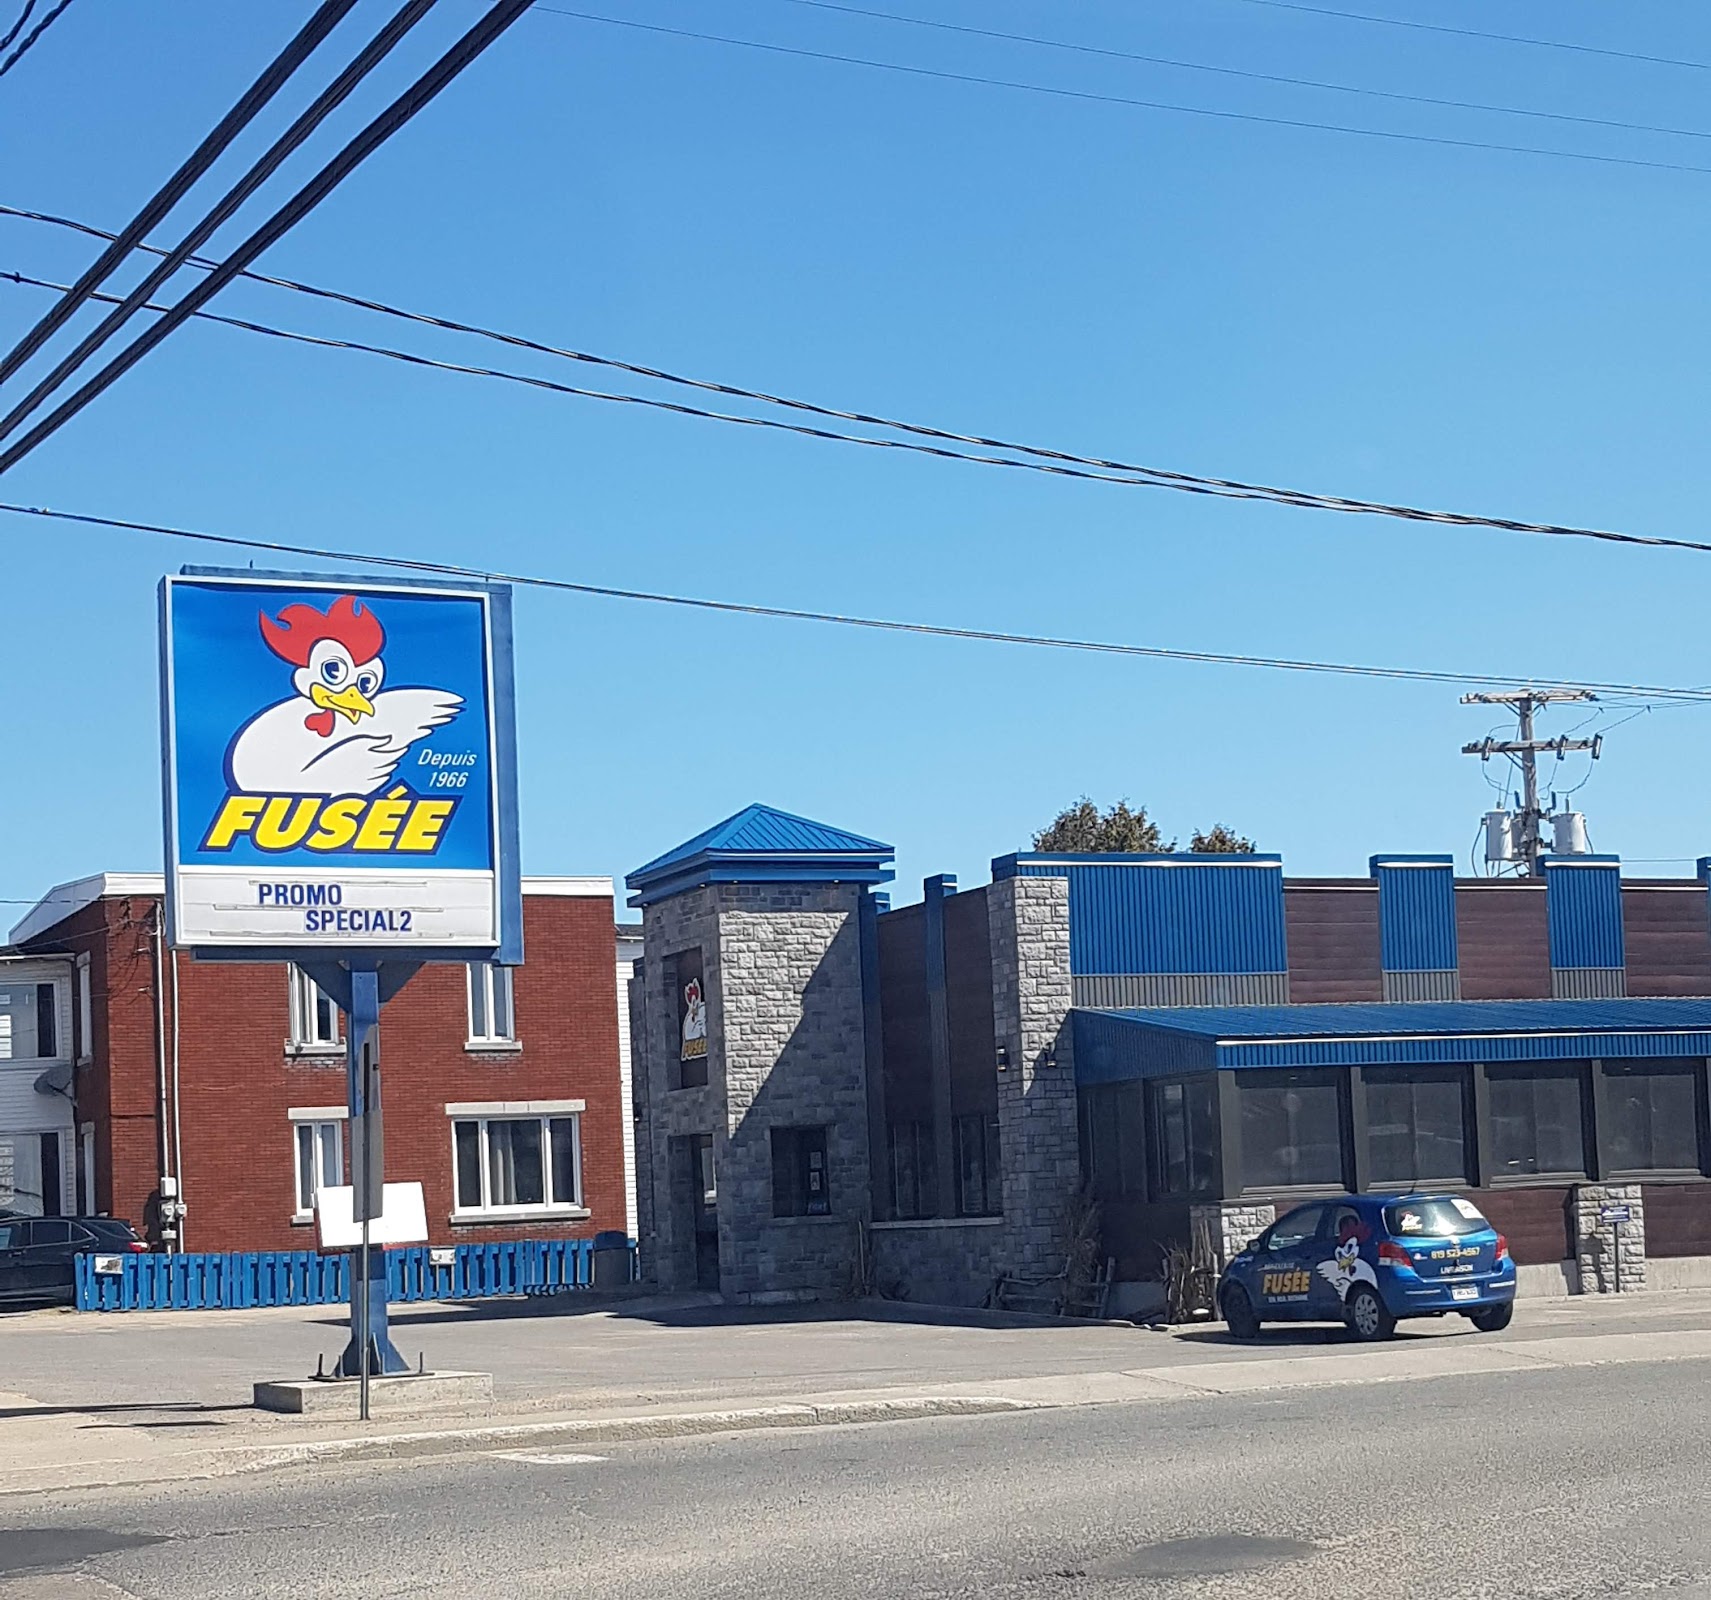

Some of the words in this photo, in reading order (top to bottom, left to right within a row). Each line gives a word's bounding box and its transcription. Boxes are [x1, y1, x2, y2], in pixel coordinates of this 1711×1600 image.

[418, 748, 477, 768] Depuis
[428, 771, 469, 788] 1966
[206, 786, 454, 851] FUSÉE
[258, 884, 342, 905] PROMO
[1262, 1267, 1312, 1295] FUSÉE
